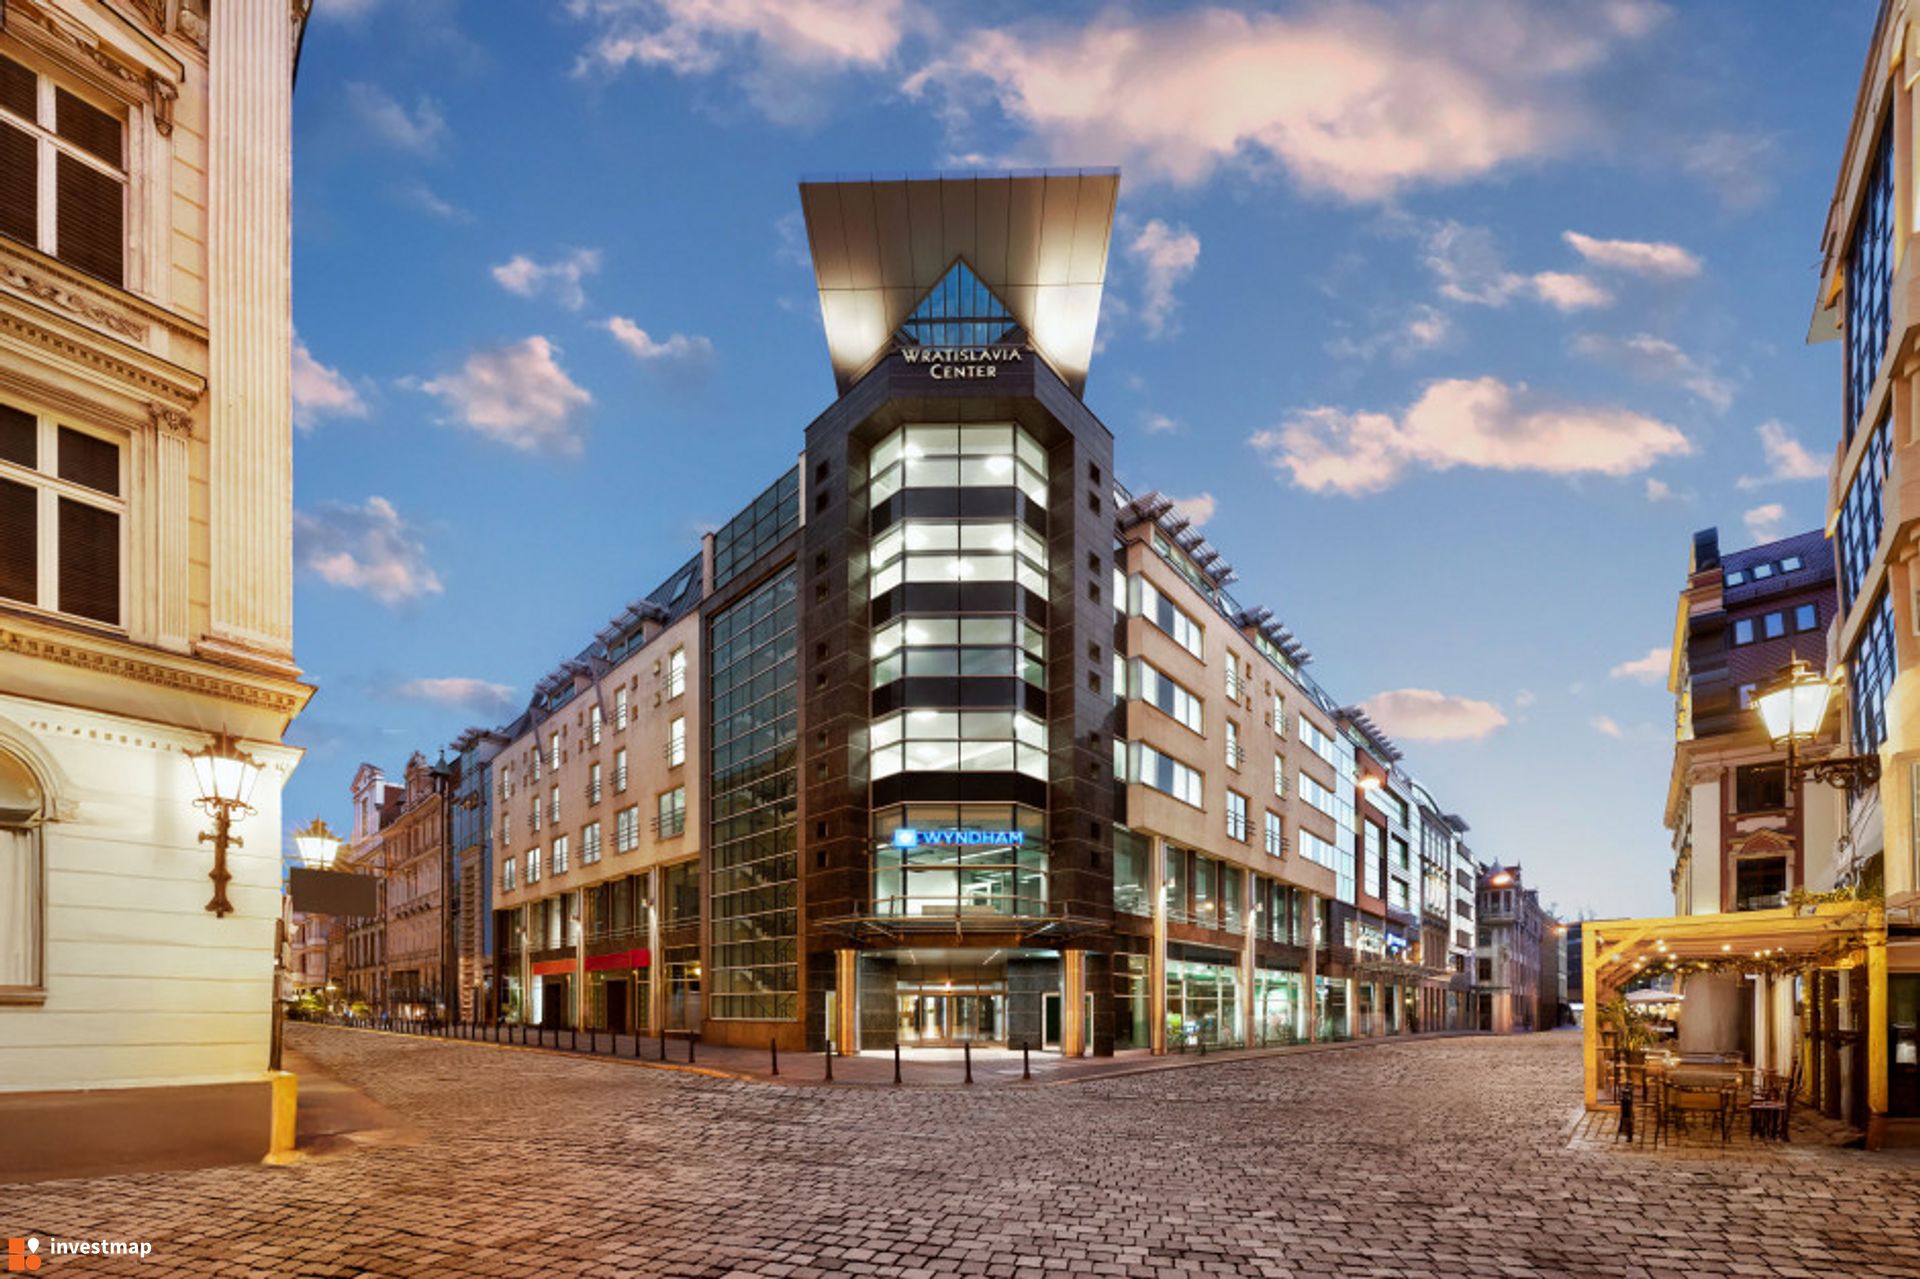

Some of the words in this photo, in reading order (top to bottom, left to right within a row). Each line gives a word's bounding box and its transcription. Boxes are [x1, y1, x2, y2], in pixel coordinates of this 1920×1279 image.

[902, 349, 1021, 363] WRATISLAVIA
[930, 363, 996, 379] CENTER
[923, 831, 1023, 844] WYNDHAM
